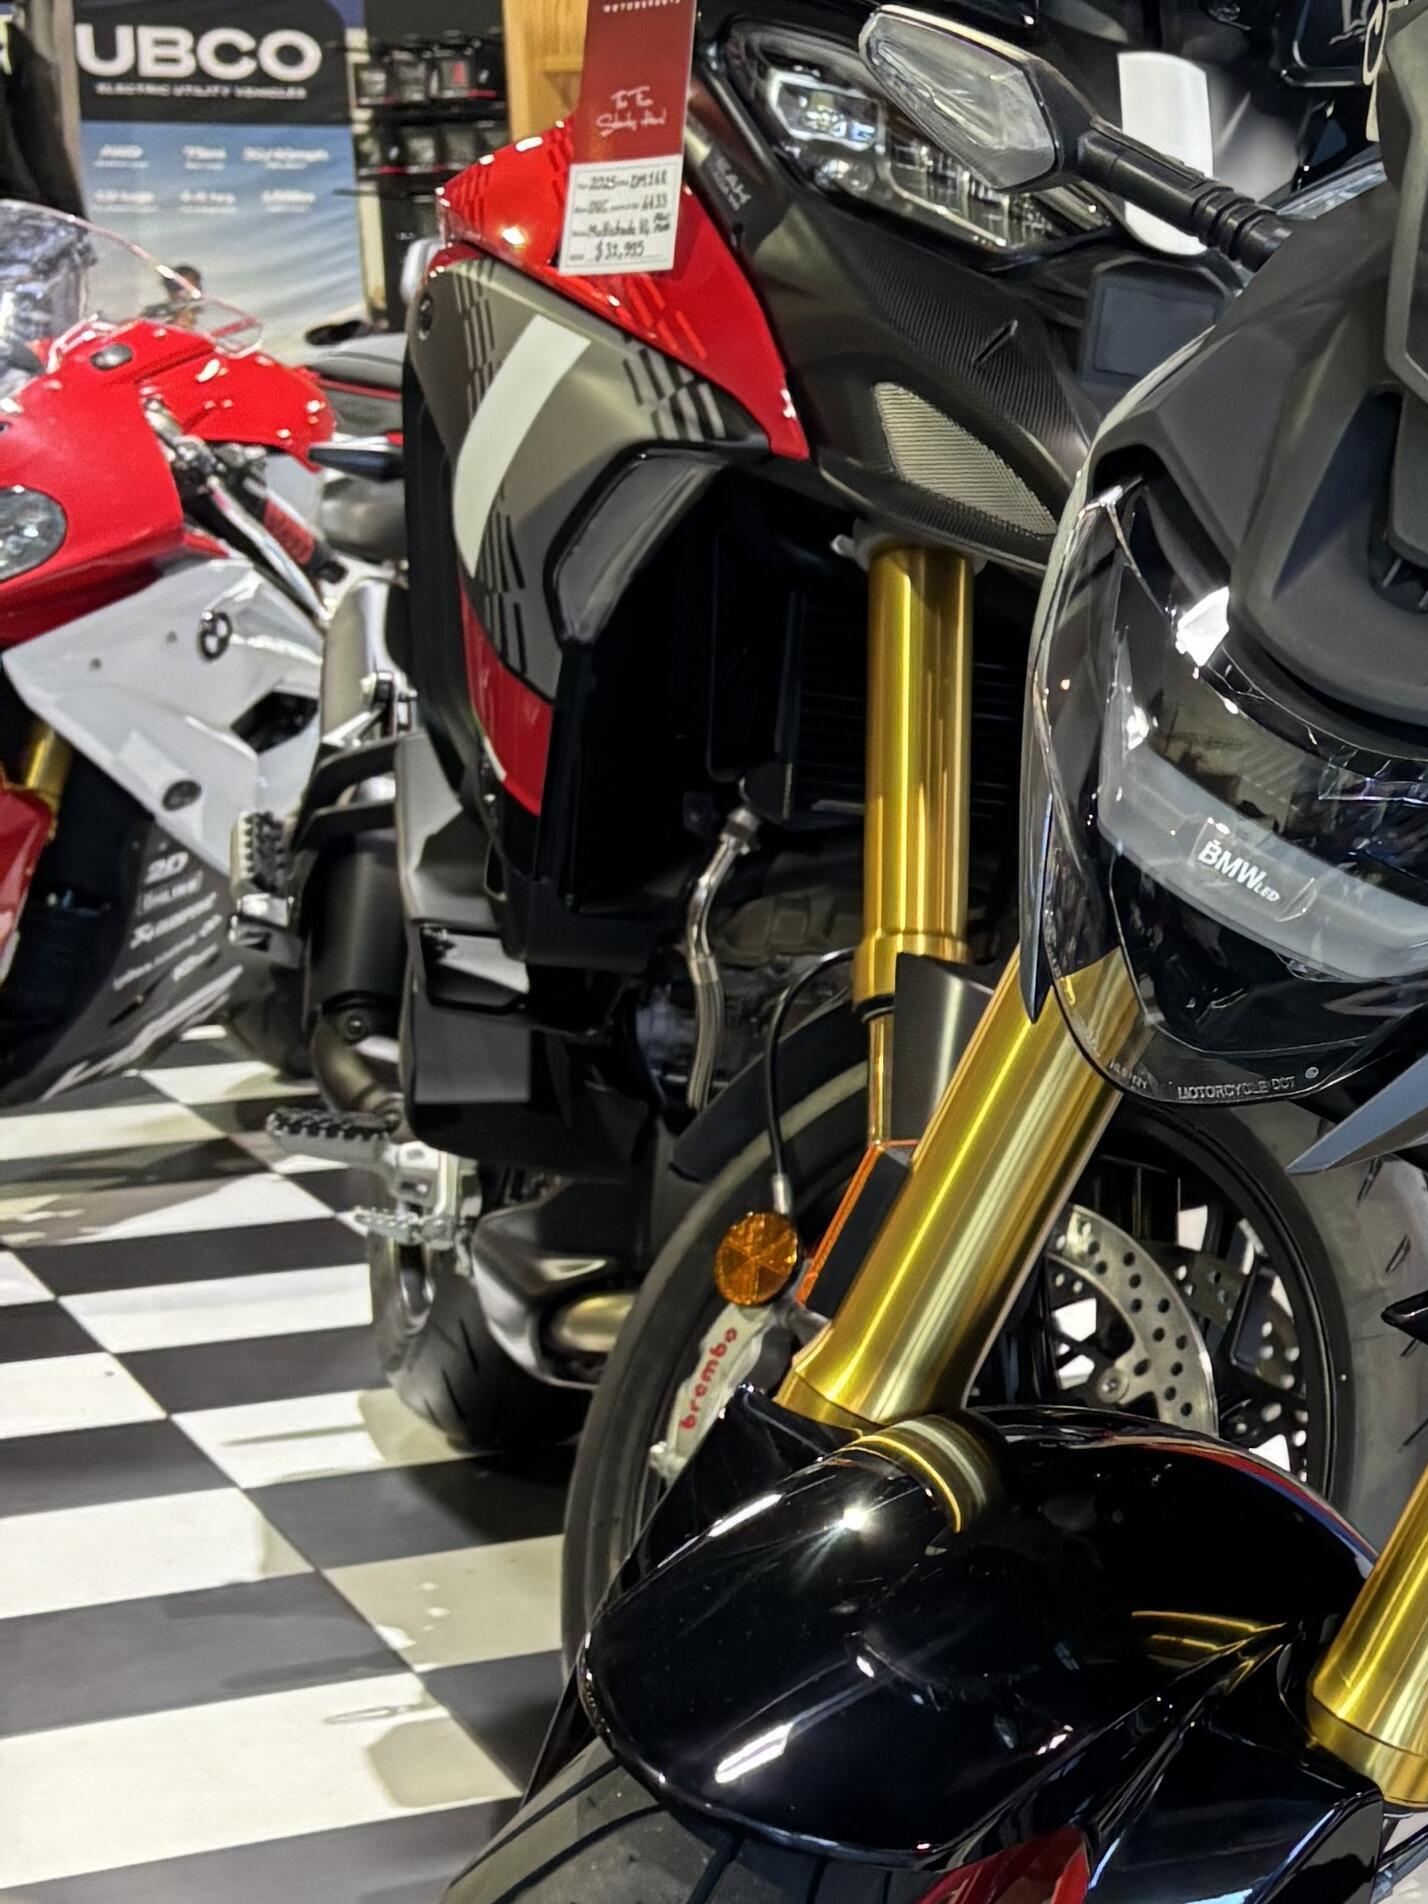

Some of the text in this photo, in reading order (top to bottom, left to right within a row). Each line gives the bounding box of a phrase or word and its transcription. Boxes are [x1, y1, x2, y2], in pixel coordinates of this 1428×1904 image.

[75, 22, 322, 82] UBCO
[1198, 840, 1267, 889] BMW
[680, 1327, 737, 1430] brembo
